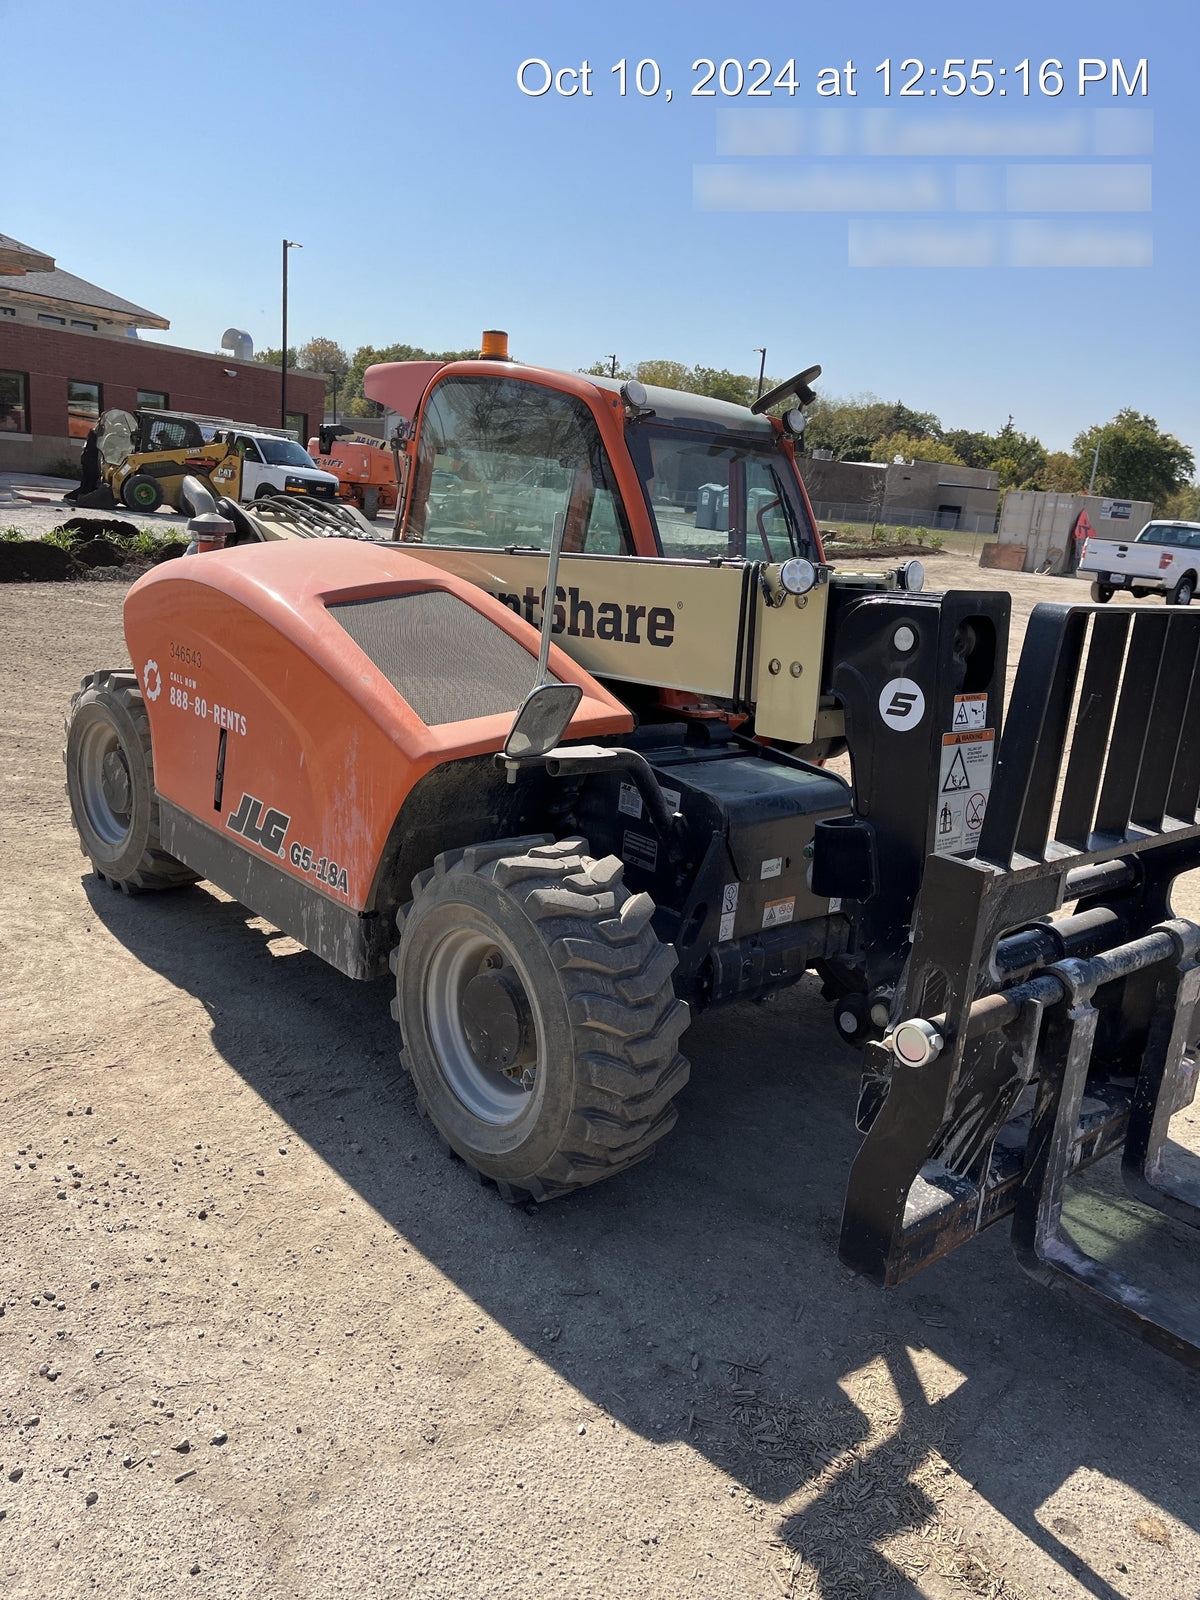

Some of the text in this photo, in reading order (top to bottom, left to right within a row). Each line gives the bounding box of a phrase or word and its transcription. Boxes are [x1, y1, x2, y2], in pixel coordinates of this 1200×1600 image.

[366, 438, 379, 448] LIFT
[218, 468, 233, 478] CAT
[323, 458, 344, 468] LIFT
[488, 586, 675, 647] ntShare
[169, 642, 202, 668] 346543
[170, 672, 197, 690] CALL NOW
[170, 686, 247, 736] 888-80-RENTS
[226, 792, 291, 857] JLG
[290, 841, 349, 896] G5-18A
